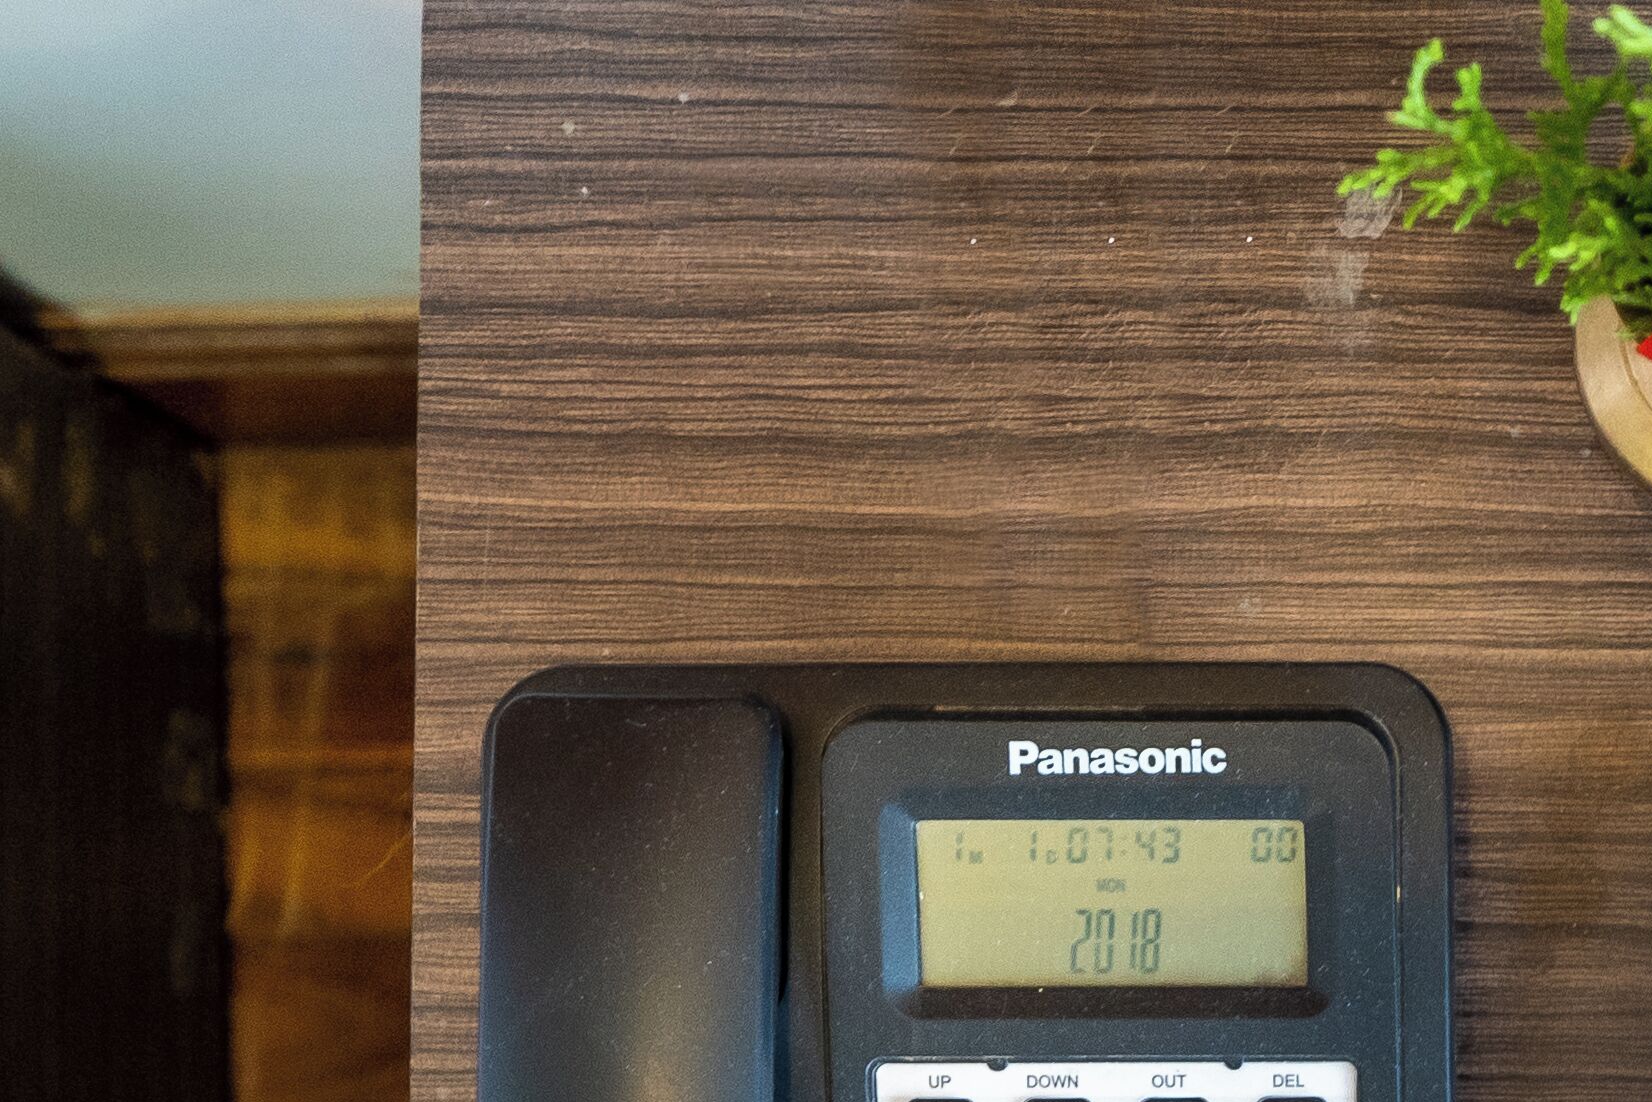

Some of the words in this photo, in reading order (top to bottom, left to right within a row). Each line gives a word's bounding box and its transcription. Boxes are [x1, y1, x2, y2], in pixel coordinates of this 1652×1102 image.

[1009, 739, 1226, 775] Panasonic
[1252, 827, 1298, 863] 00
[1069, 908, 1162, 973] 2018
[929, 1075, 951, 1088] UP
[1027, 1075, 1078, 1088] DOWN
[1152, 1075, 1186, 1088] OUT
[1273, 1074, 1304, 1087] DEL
